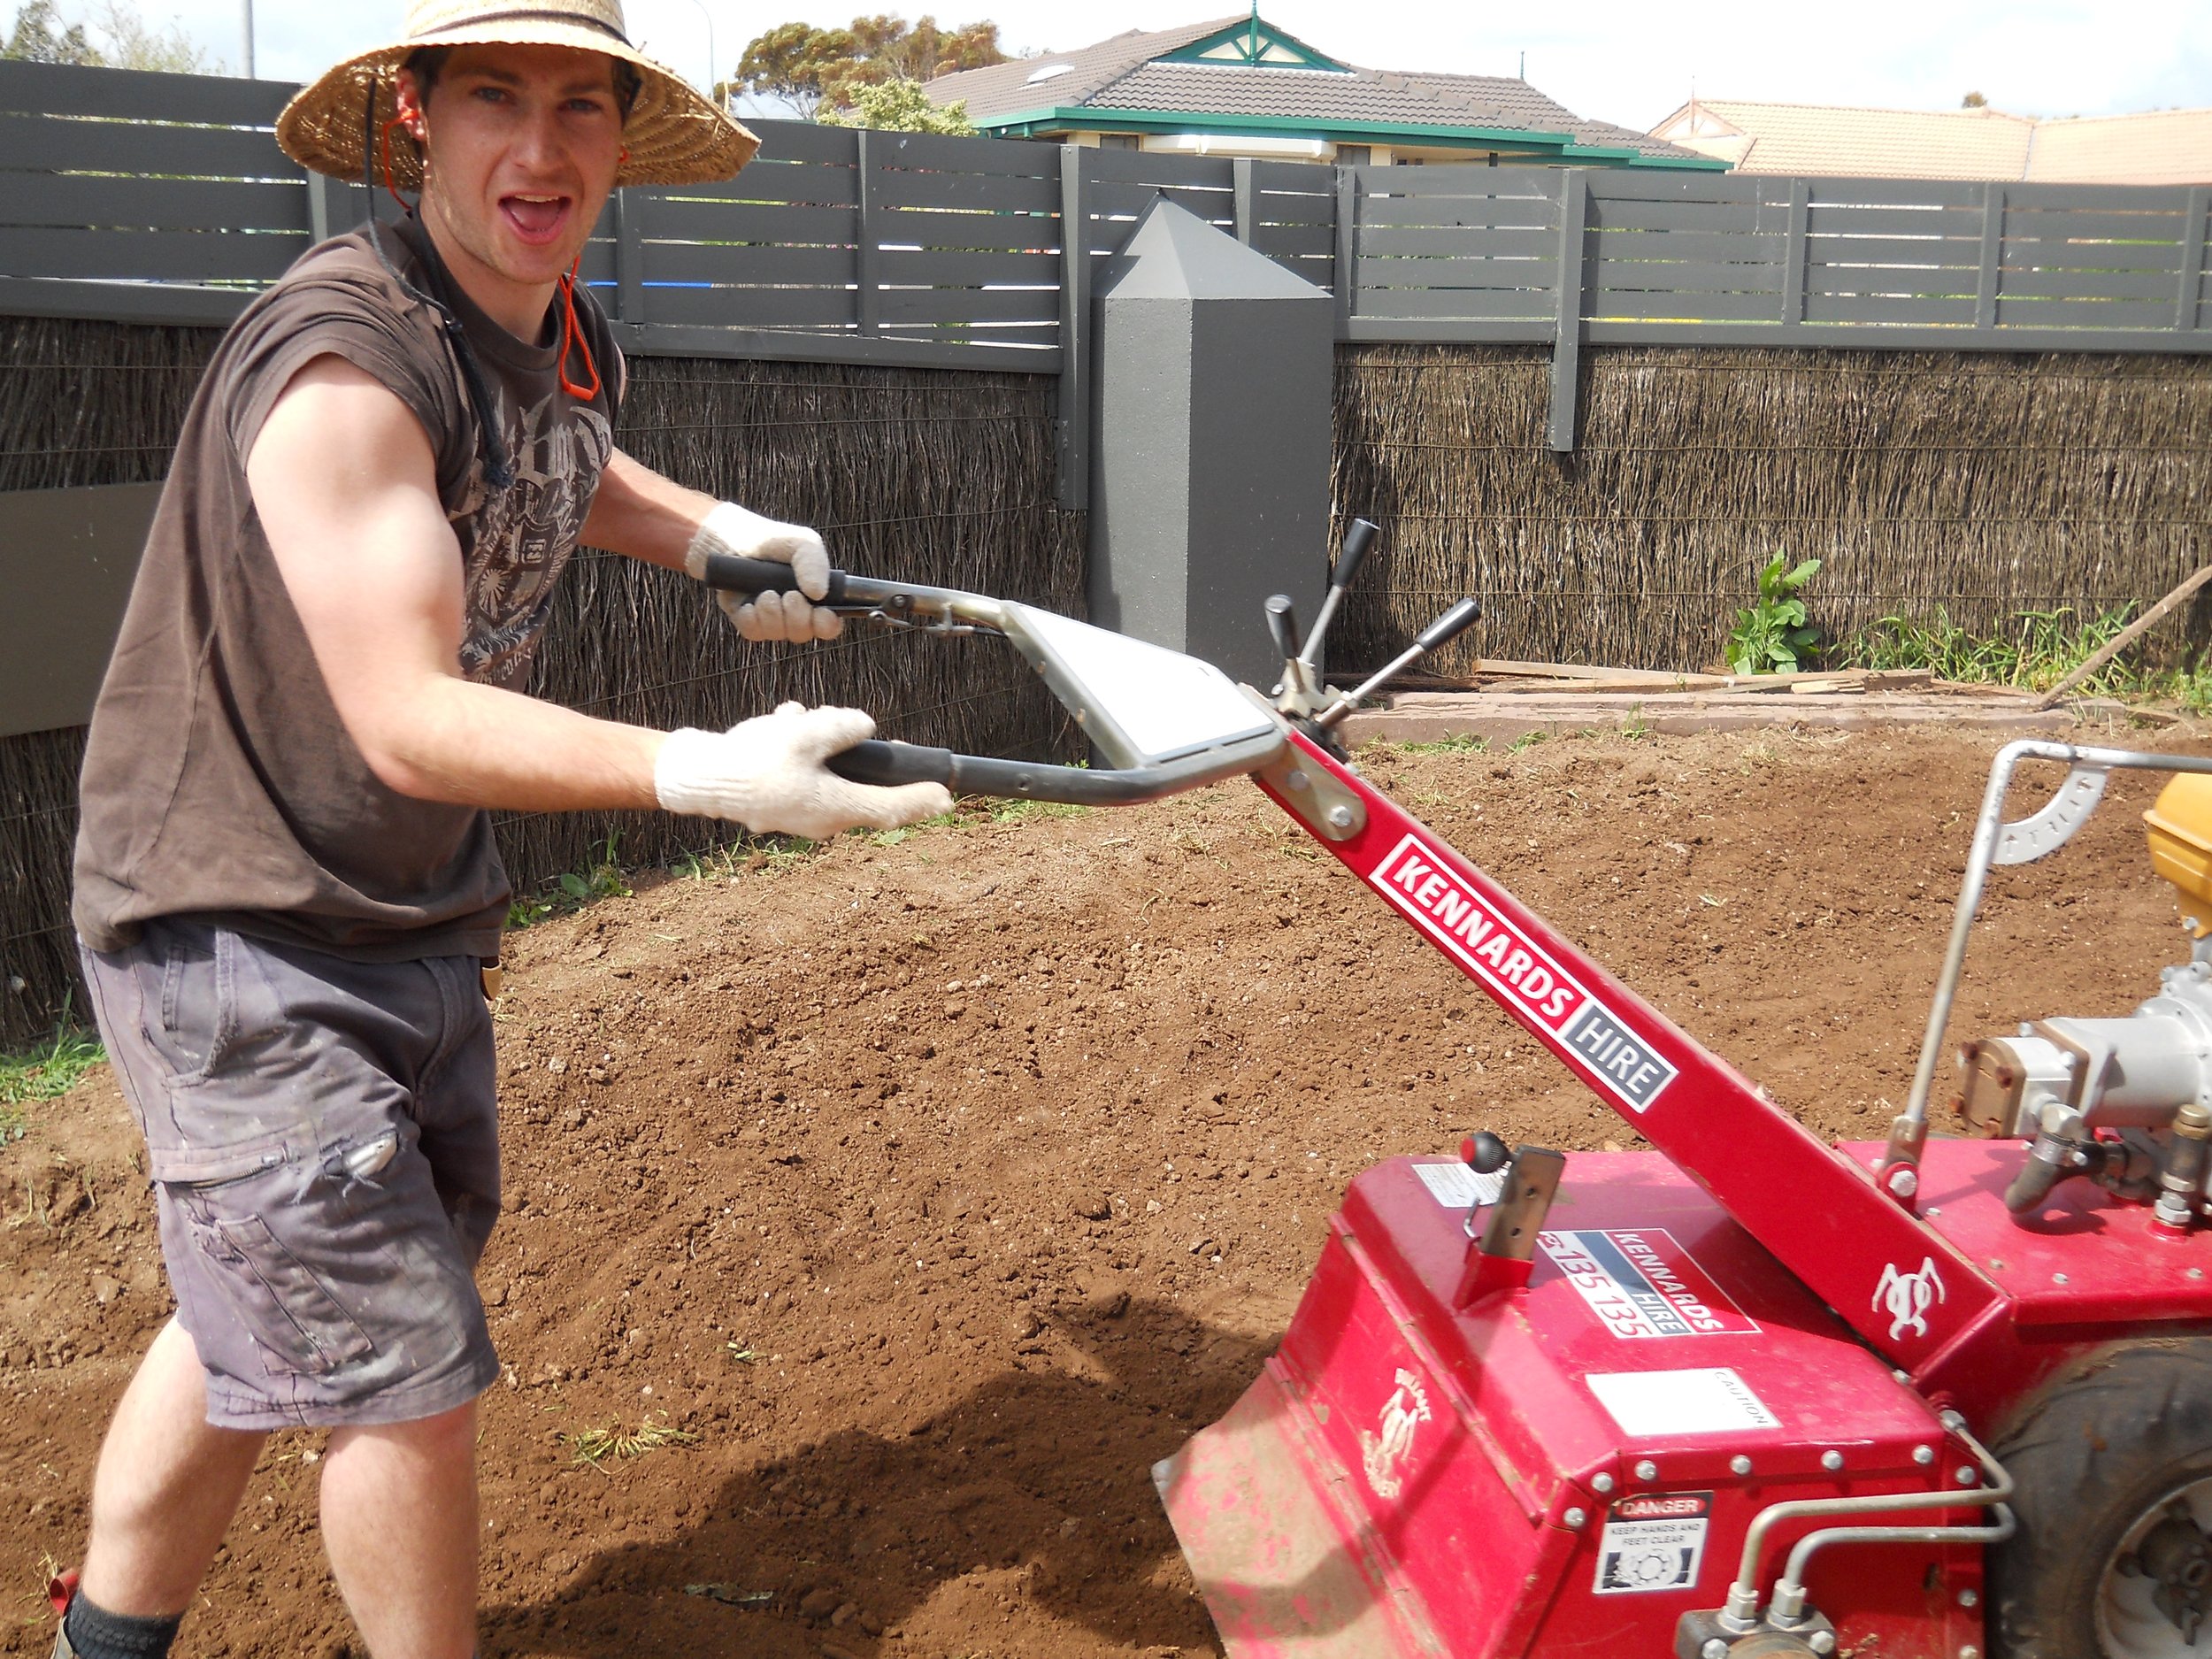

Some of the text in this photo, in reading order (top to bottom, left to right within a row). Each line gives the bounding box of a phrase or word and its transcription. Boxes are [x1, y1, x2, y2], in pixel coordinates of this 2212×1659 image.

[1393, 855, 1660, 1094] KENNARDS HIRE
[1555, 1249, 1653, 1336] 135 135
[1615, 1233, 1724, 1331] KENNARDS
[1632, 1293, 1685, 1333] HIRE
[1714, 1371, 1769, 1425] CAUTION
[1610, 1526, 1637, 1536] KEEP
[1640, 1524, 1677, 1532] HANDS
[1622, 1499, 1699, 1516] DANGER
[1623, 1535, 1685, 1546] FEET CLEAR
